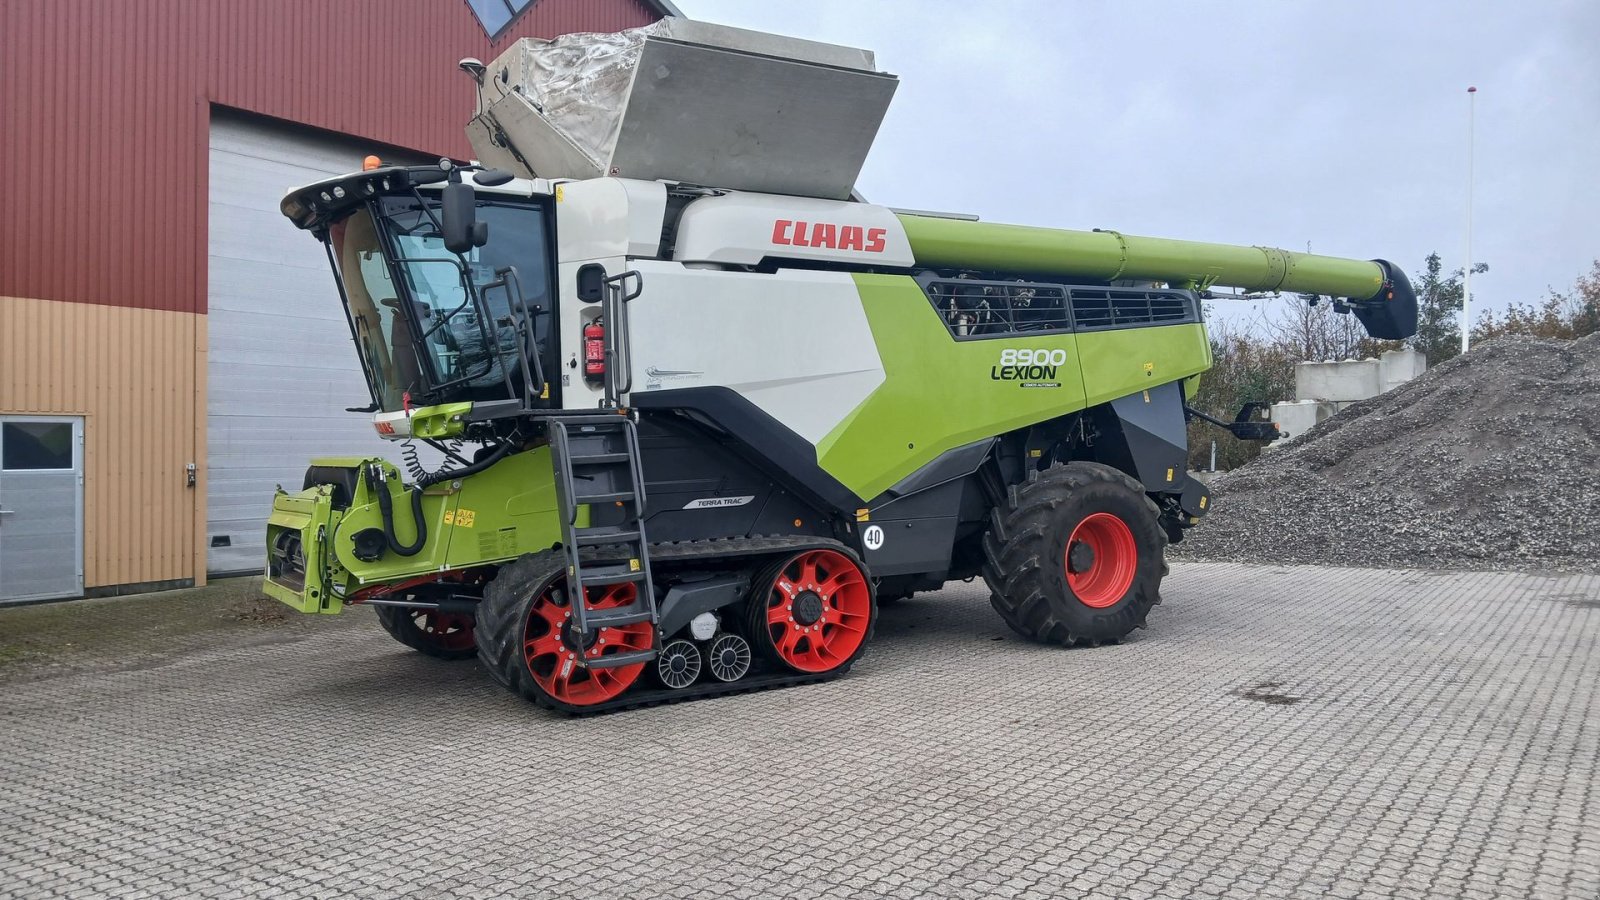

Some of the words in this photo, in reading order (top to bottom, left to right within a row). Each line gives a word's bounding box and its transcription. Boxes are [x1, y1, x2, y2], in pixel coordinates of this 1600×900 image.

[772, 219, 887, 253] CLAAS
[1000, 348, 1067, 367] 8900
[991, 366, 1057, 380] LEXION
[697, 499, 722, 507] TERRA
[723, 497, 743, 505] TRAC
[867, 529, 881, 545] 40
